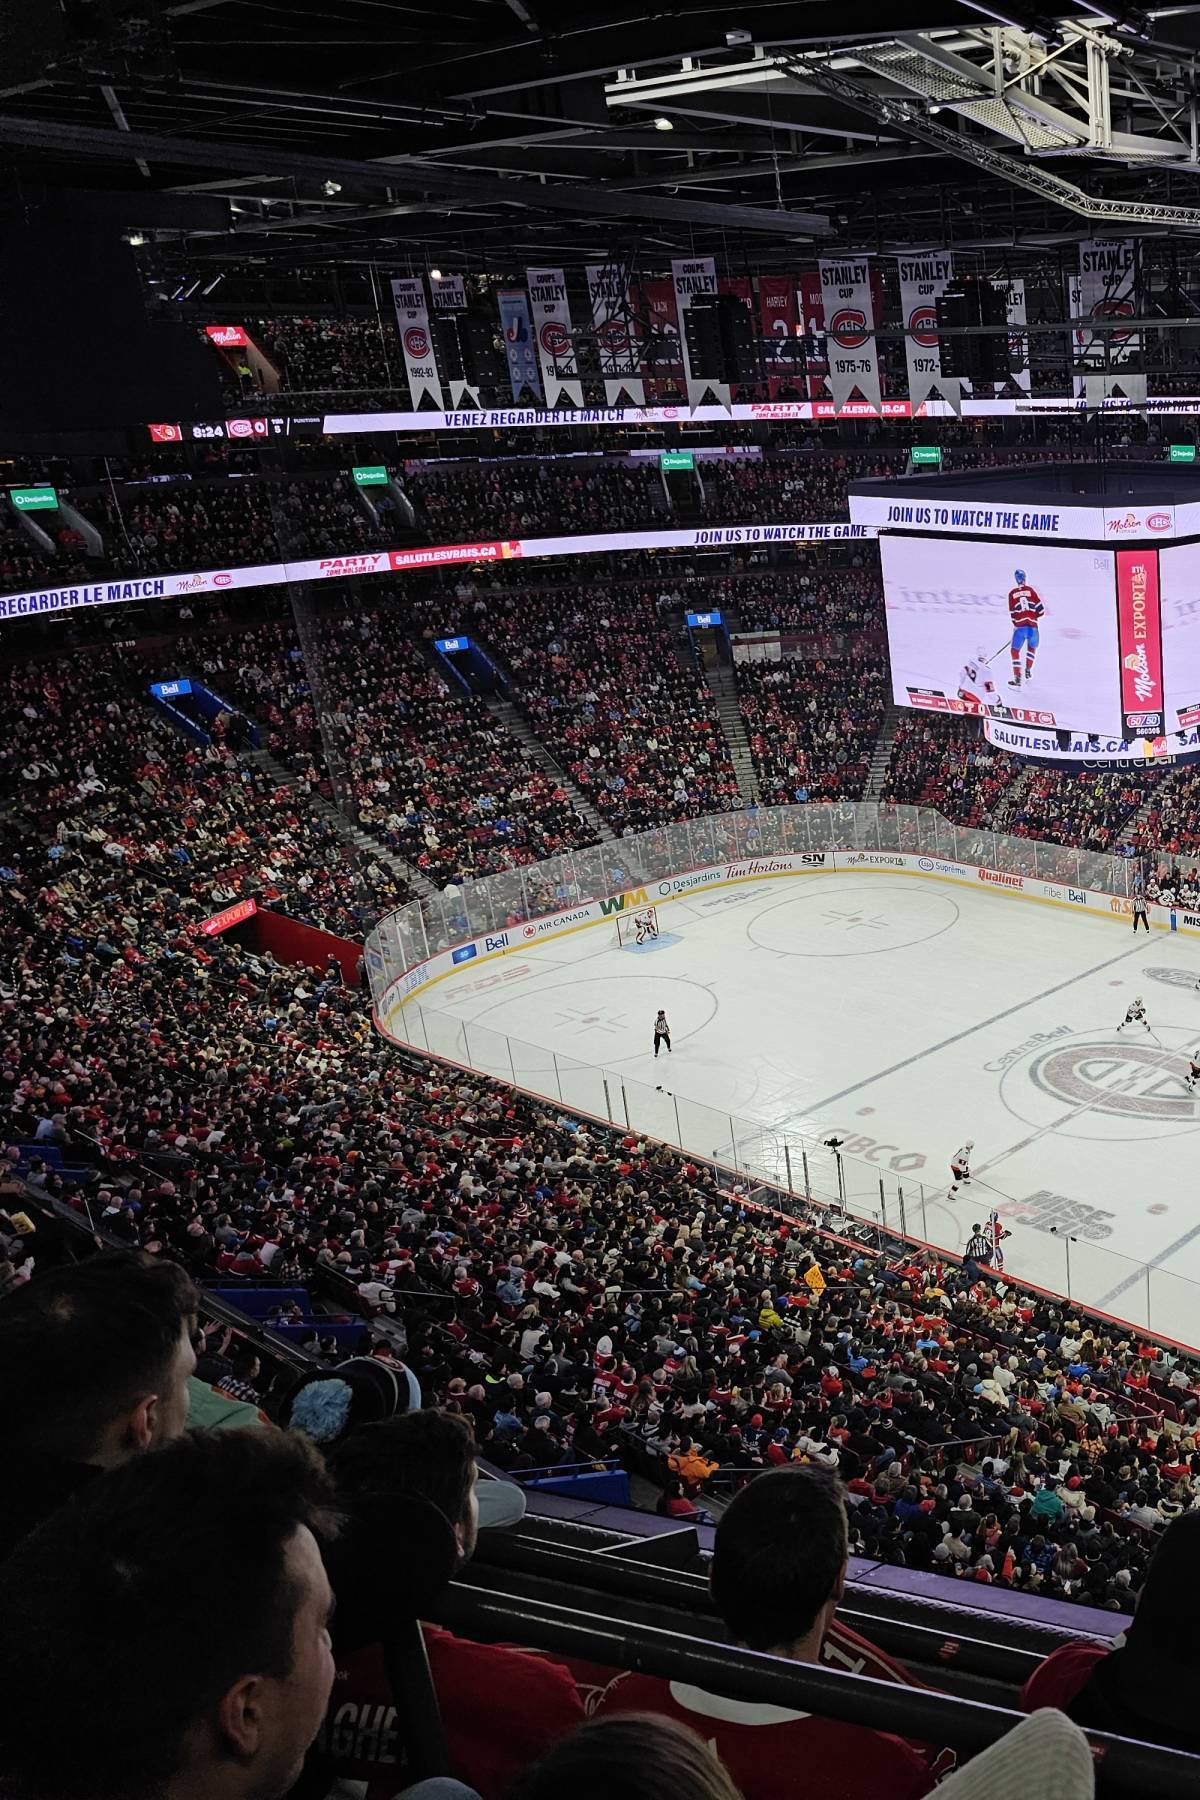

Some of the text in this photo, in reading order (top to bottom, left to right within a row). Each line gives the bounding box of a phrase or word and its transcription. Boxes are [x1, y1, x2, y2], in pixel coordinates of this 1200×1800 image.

[682, 263, 704, 274] COUPE
[822, 266, 867, 286] STANLEY
[900, 262, 950, 281] STANLEY
[536, 274, 556, 284] COUPE
[676, 276, 716, 294] STANLEY
[530, 286, 566, 302] STANLEY
[839, 288, 854, 298] CUP
[918, 284, 934, 296] CUP
[395, 294, 424, 309] STANLEY
[544, 304, 556, 314] CUP
[766, 296, 788, 308] HARVEY
[410, 367, 434, 378] 1992-93
[835, 360, 871, 373] 1975-76
[445, 408, 624, 426] VENEZ REGARDER LE MATCH
[192, 426, 224, 438] 8:24
[255, 422, 264, 432] 0
[888, 506, 1060, 532] JOIN US TO WATCH THE GAME
[694, 524, 868, 544] JOIN US TO WATCH THE GAME
[320, 555, 382, 570] PARTY
[396, 546, 497, 566] SALUTLESVRAIS.CA
[84, 587, 102, 604] LE
[108, 579, 164, 600] MATCH
[1134, 582, 1146, 640] EXPORT
[697, 616, 711, 624] Bell
[445, 640, 459, 650] Bell
[1134, 643, 1153, 702] Molson
[161, 684, 179, 695] Bell
[801, 852, 826, 864] SN
[870, 856, 900, 866] EXPORT
[724, 860, 793, 880] Tim Hortons
[935, 862, 966, 876] Suprême
[673, 870, 721, 892] Desjardins
[978, 868, 1024, 888] Qualinet
[1043, 886, 1062, 898] Fibe
[1068, 889, 1086, 904] Bell
[600, 888, 650, 916] WM
[538, 910, 590, 932] AIR CANADA
[485, 933, 510, 952] Bell
